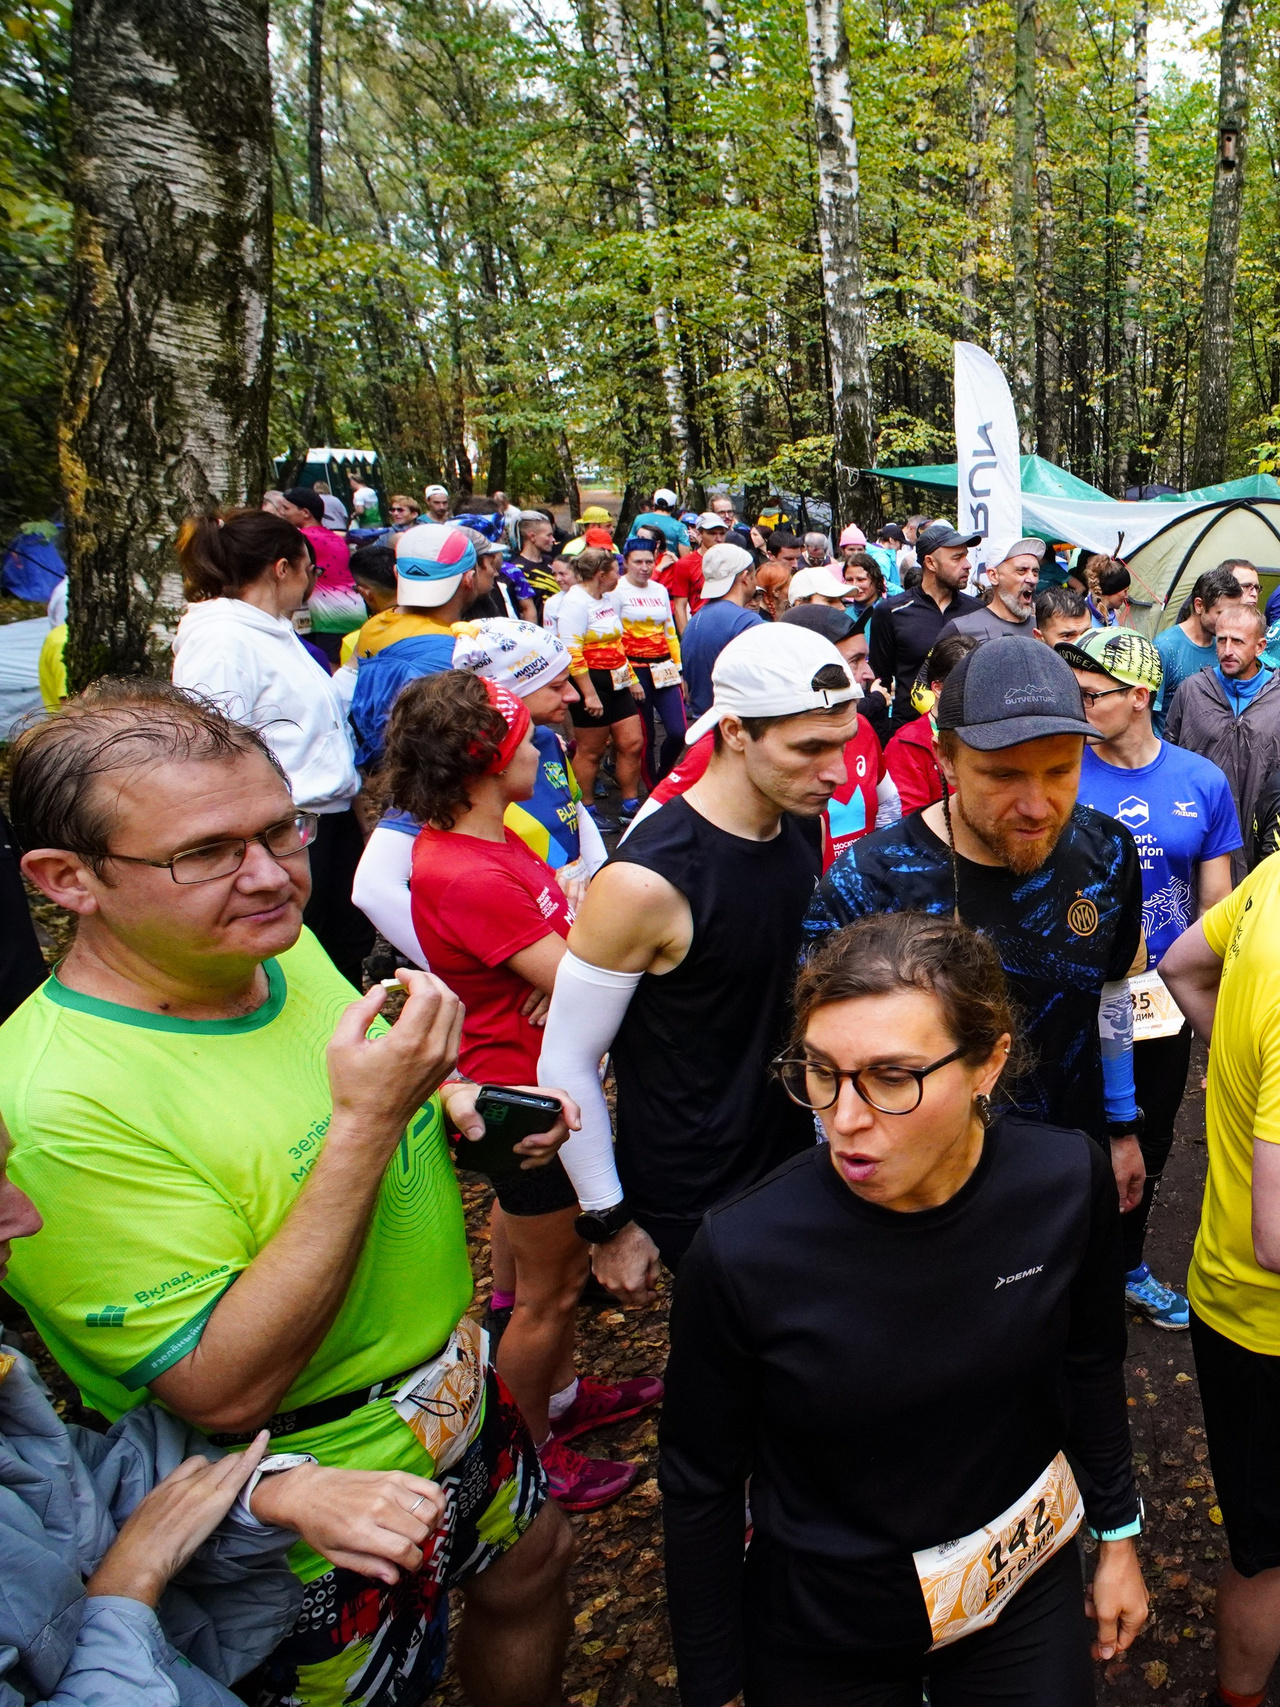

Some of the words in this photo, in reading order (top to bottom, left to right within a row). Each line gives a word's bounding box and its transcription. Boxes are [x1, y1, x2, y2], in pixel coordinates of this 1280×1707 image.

[1133, 1011, 1155, 1022] дим
[134, 1270, 194, 1303] Вклад
[1005, 1264, 1044, 1285] DEMIX
[987, 1497, 1051, 1581] 142
[985, 1524, 1055, 1603] Евгения
